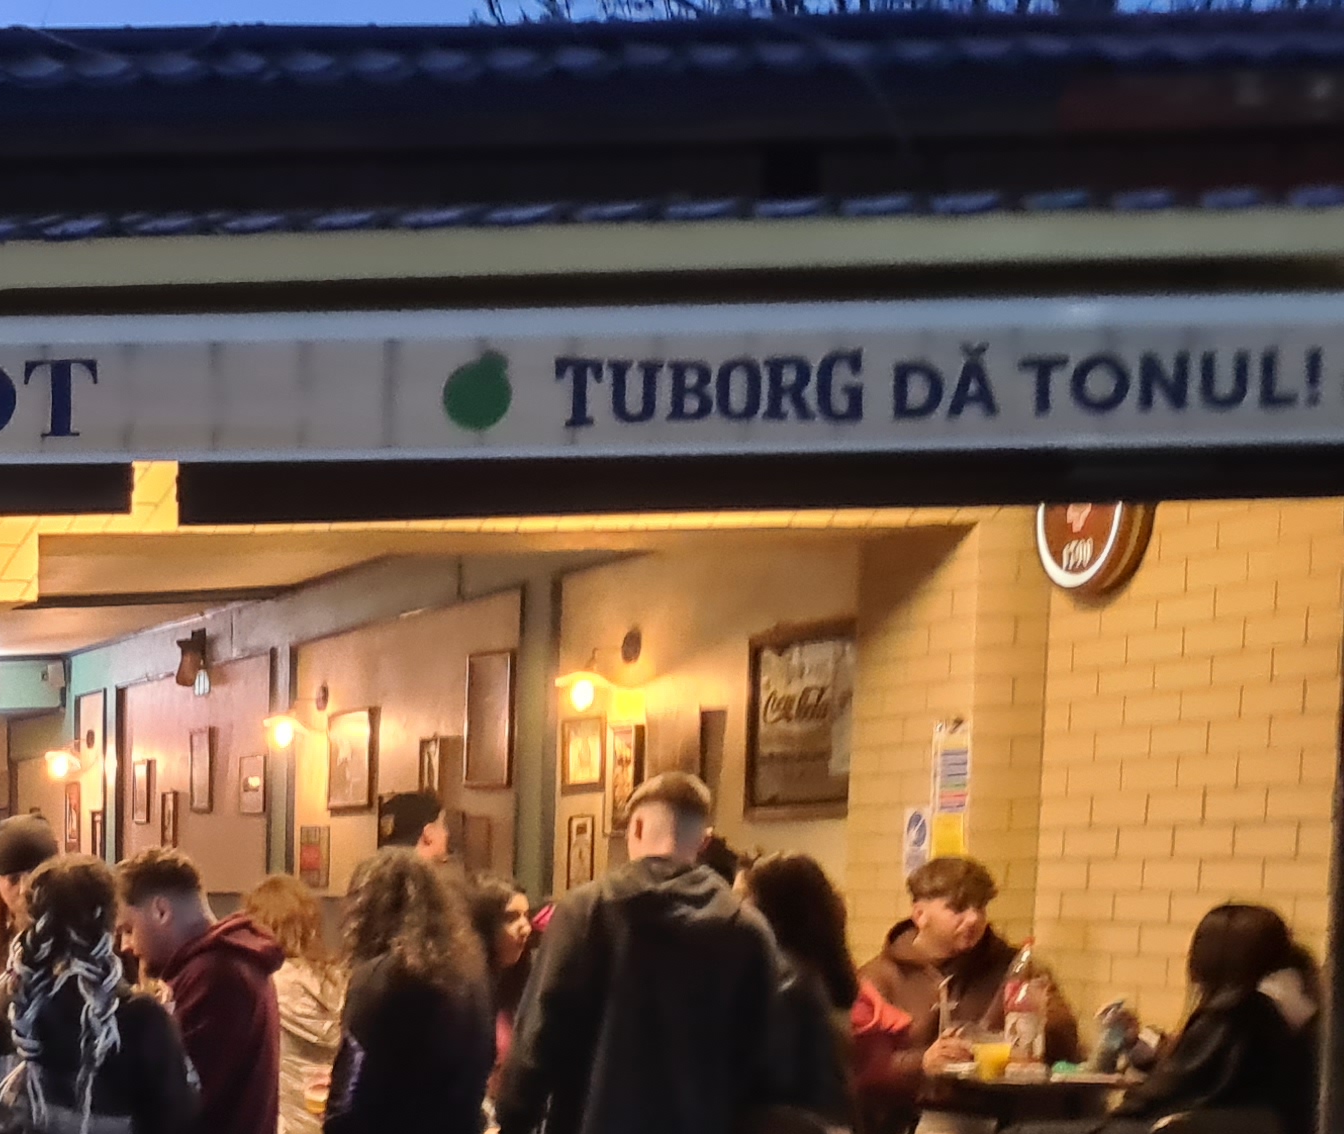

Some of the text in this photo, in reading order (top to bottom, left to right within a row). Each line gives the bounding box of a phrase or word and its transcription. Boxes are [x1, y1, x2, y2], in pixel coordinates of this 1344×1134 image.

[554, 341, 1322, 428] TUBORG DĂ TONUL!
